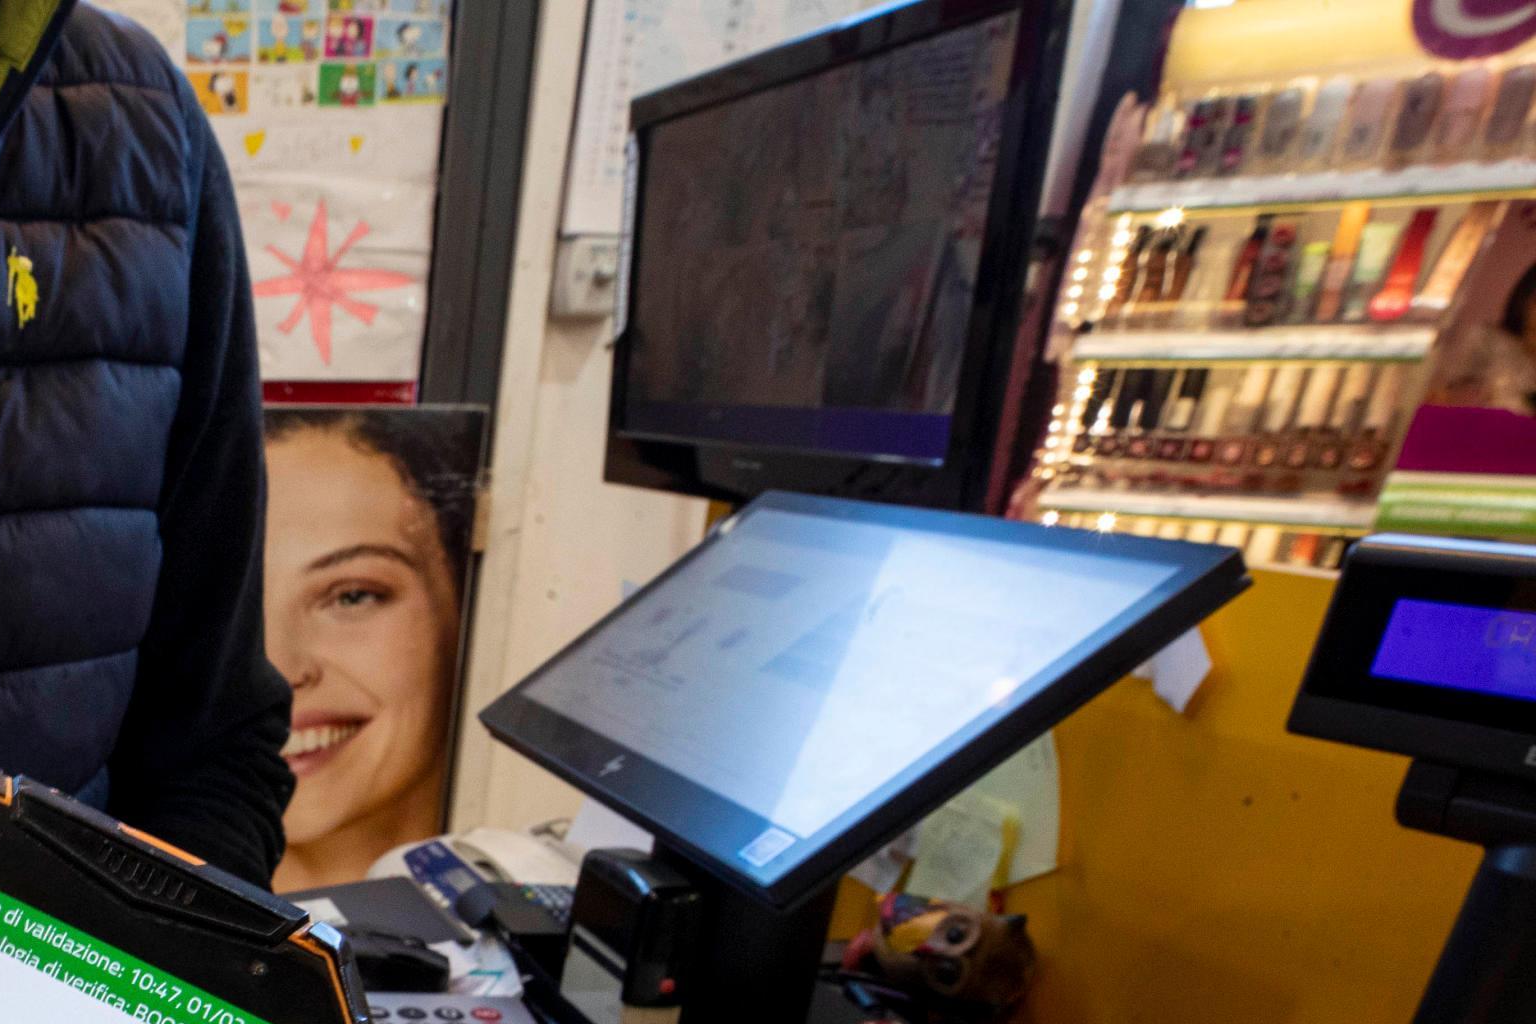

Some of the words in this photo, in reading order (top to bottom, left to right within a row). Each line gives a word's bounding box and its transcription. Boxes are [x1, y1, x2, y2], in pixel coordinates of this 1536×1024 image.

[3, 908, 23, 927] di
[23, 919, 124, 977] validazione:
[131, 969, 181, 1008] 10:47,
[42, 961, 61, 978] di
[63, 971, 130, 1012] verifica:
